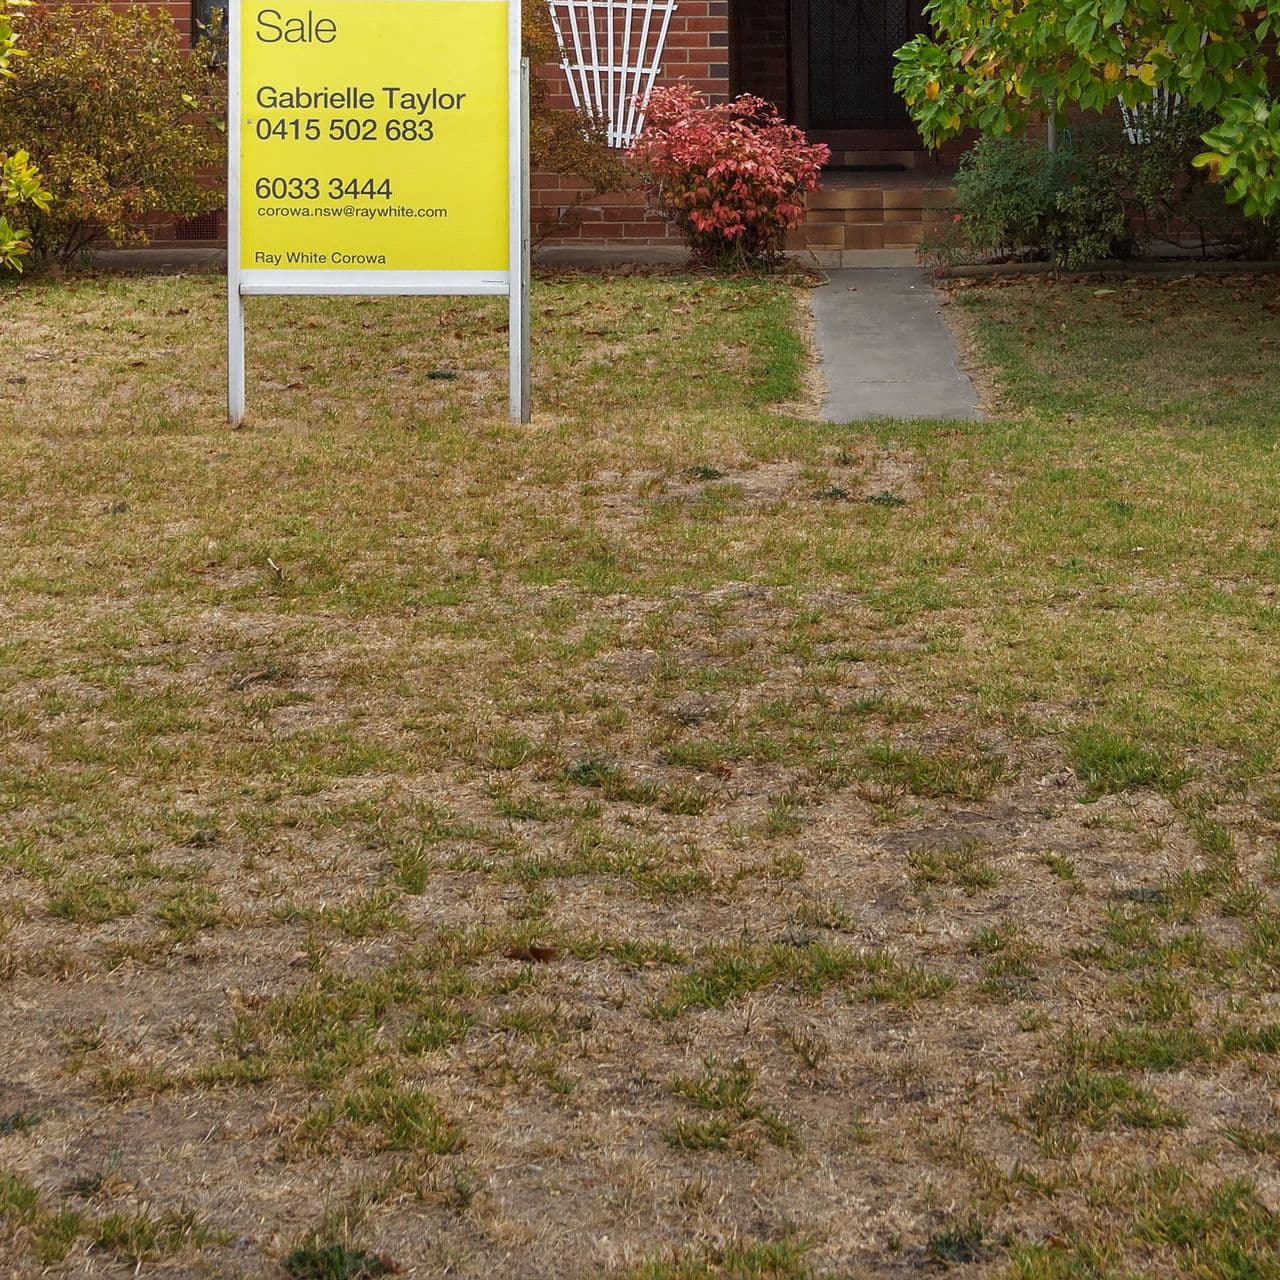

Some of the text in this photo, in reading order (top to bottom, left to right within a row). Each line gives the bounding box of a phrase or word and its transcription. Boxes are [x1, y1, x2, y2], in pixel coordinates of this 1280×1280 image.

[256, 9, 337, 44] Sale
[256, 86, 467, 115] Gabrielle Taylor
[256, 118, 434, 142] 0415 502 683
[255, 177, 393, 200] 6033 3444
[257, 205, 448, 220] corowa.nsw@raywhite.com
[255, 251, 387, 266] Ray White Corowa
